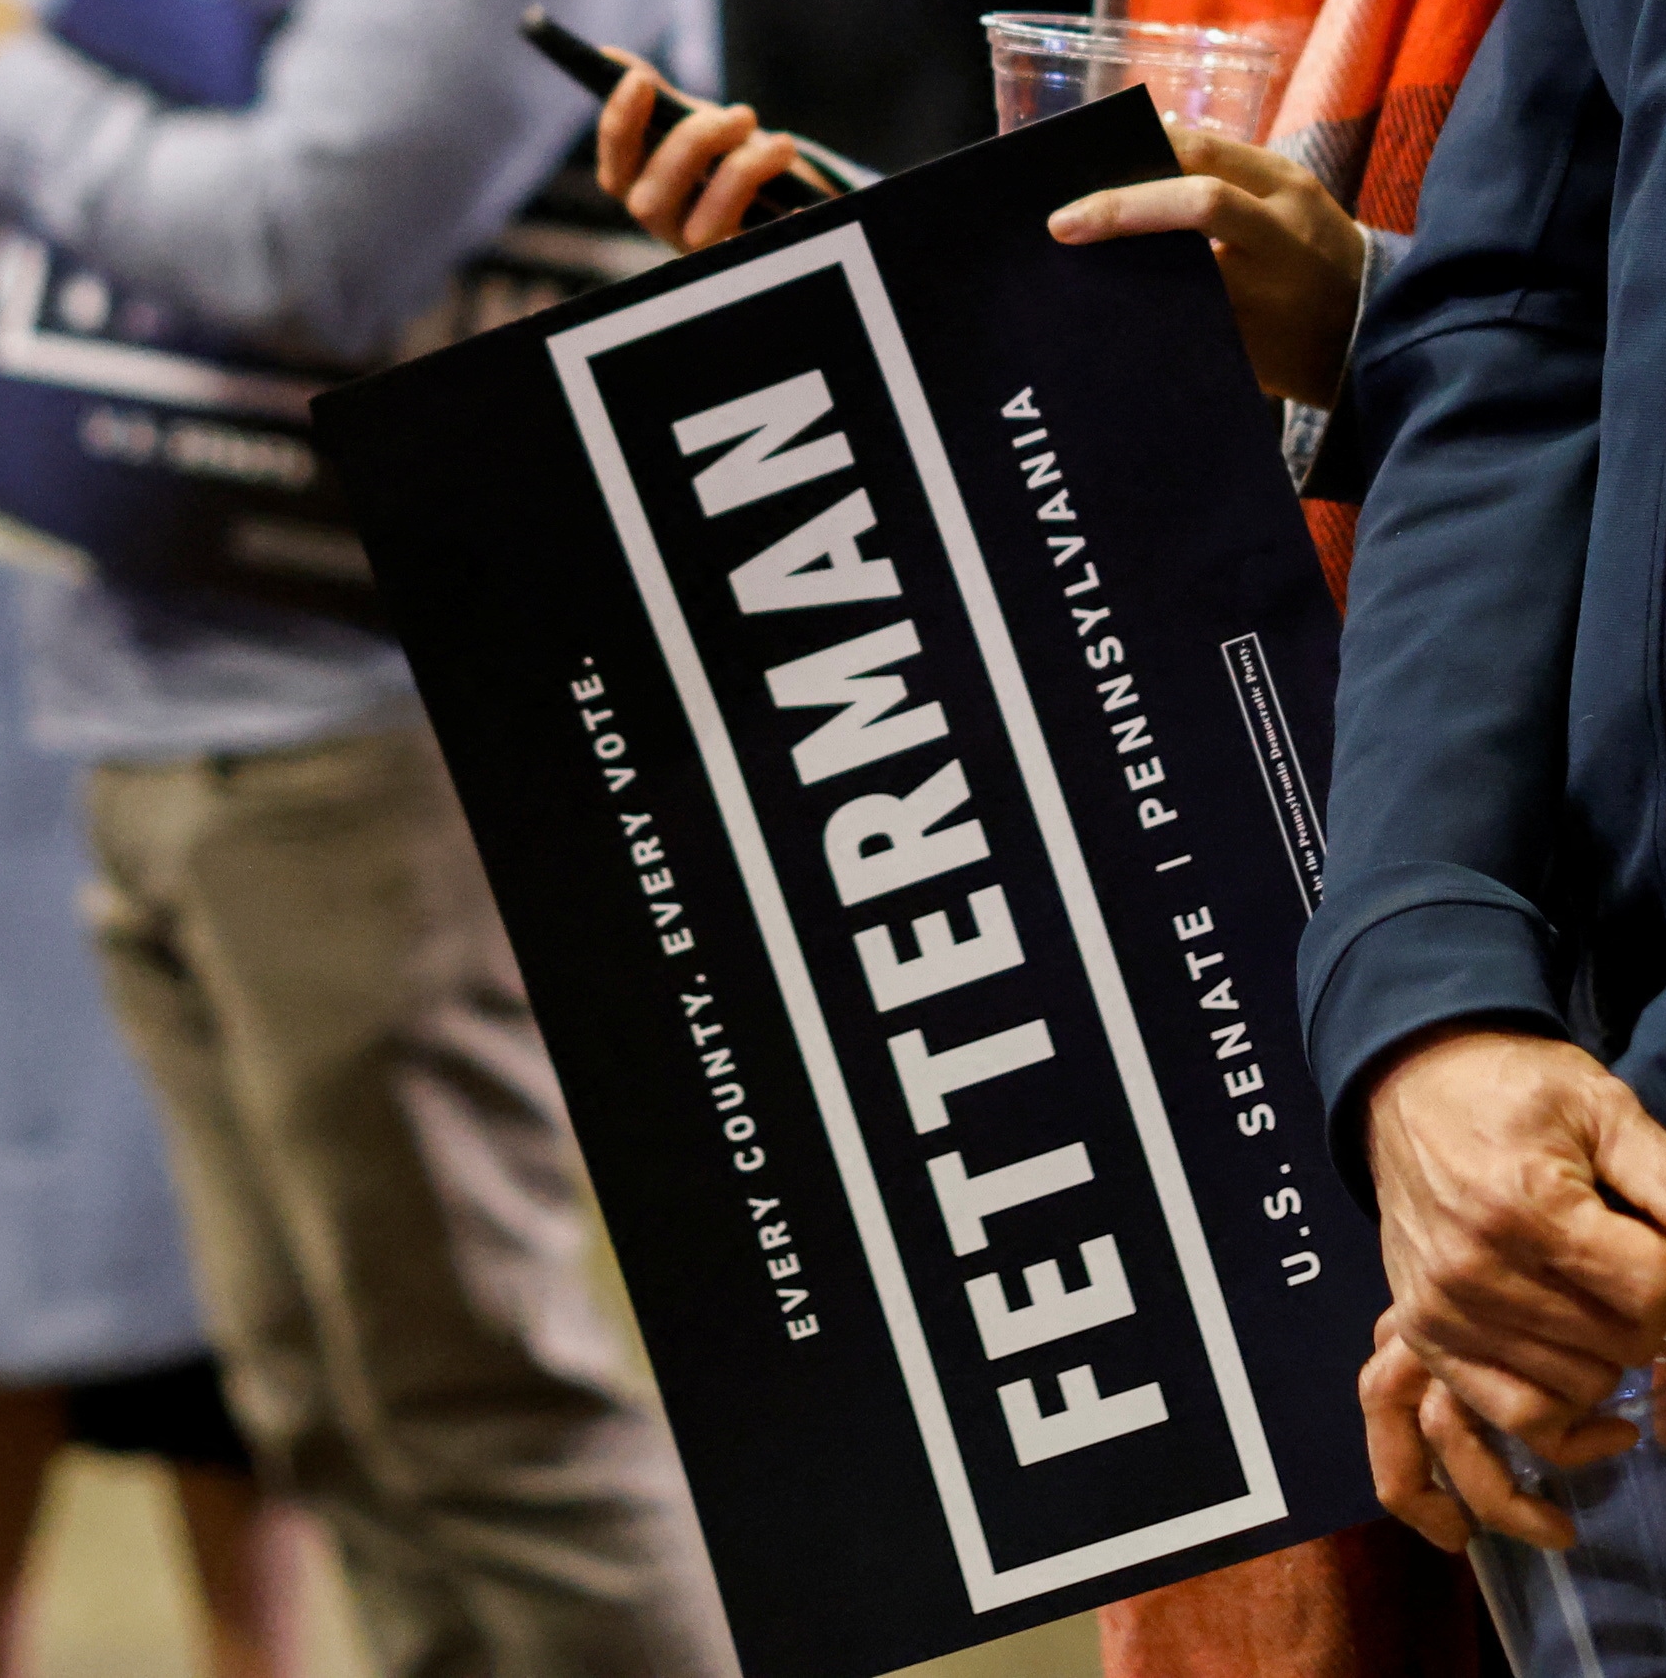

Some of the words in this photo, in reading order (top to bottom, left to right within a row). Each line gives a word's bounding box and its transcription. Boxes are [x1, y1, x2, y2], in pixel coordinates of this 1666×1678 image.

[1000, 386, 1178, 830] PENNSYLVANIA
[1238, 642, 1258, 684] Party.
[570, 655, 637, 794] VOTE.
[1251, 686, 1283, 760] Democratic
[1276, 760, 1311, 849] Pennsylvania
[1304, 849, 1319, 872] the
[619, 812, 696, 956] EVERY
[671, 369, 1170, 1467] FETTERMAN
[680, 972, 767, 1173] COUNTY.
[1172, 905, 1277, 1138] SENATE
[747, 1197, 821, 1342] EVERY
[1263, 1163, 1321, 1288] U.S.
